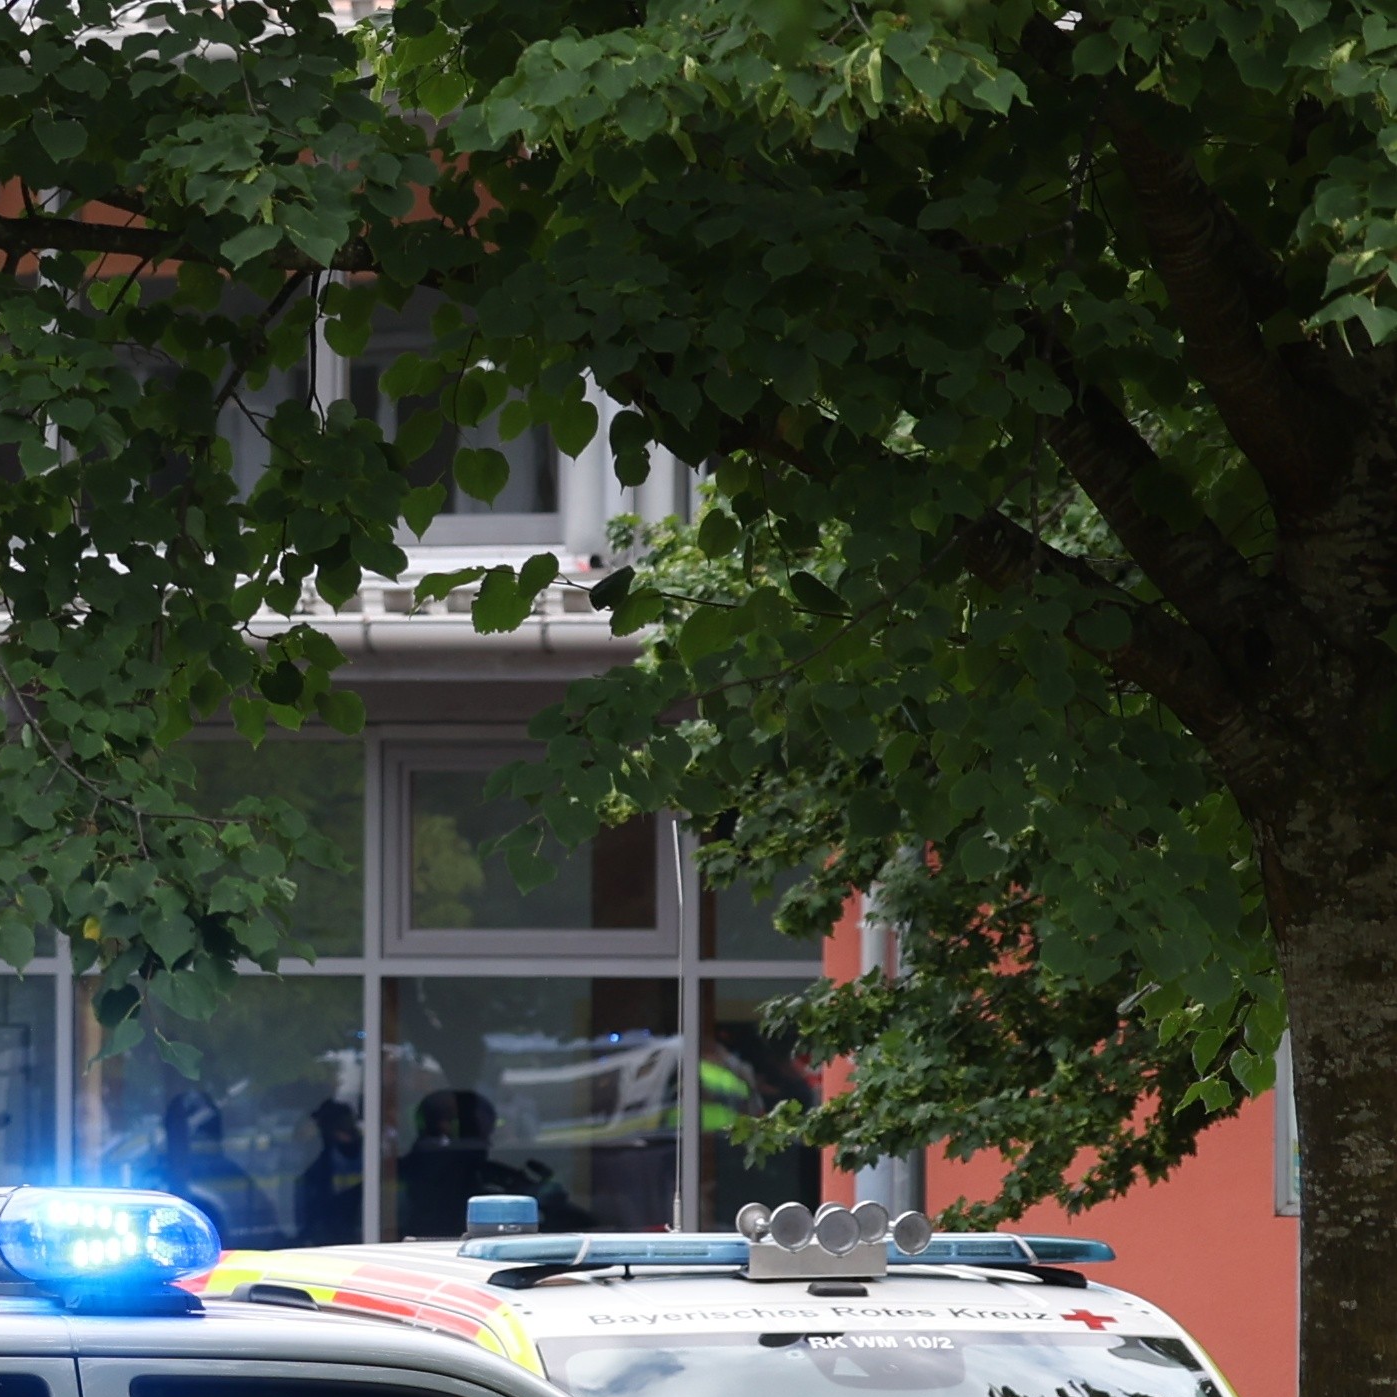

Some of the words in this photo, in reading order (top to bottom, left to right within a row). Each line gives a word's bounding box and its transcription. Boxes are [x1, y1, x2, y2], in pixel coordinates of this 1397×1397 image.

[588, 1307, 819, 1326] Bayerisches
[830, 1306, 937, 1319] Rotes
[947, 1307, 1054, 1322] Kreuz
[808, 1336, 847, 1350] RK
[852, 1336, 898, 1350] WM
[905, 1336, 955, 1350] 10/2
